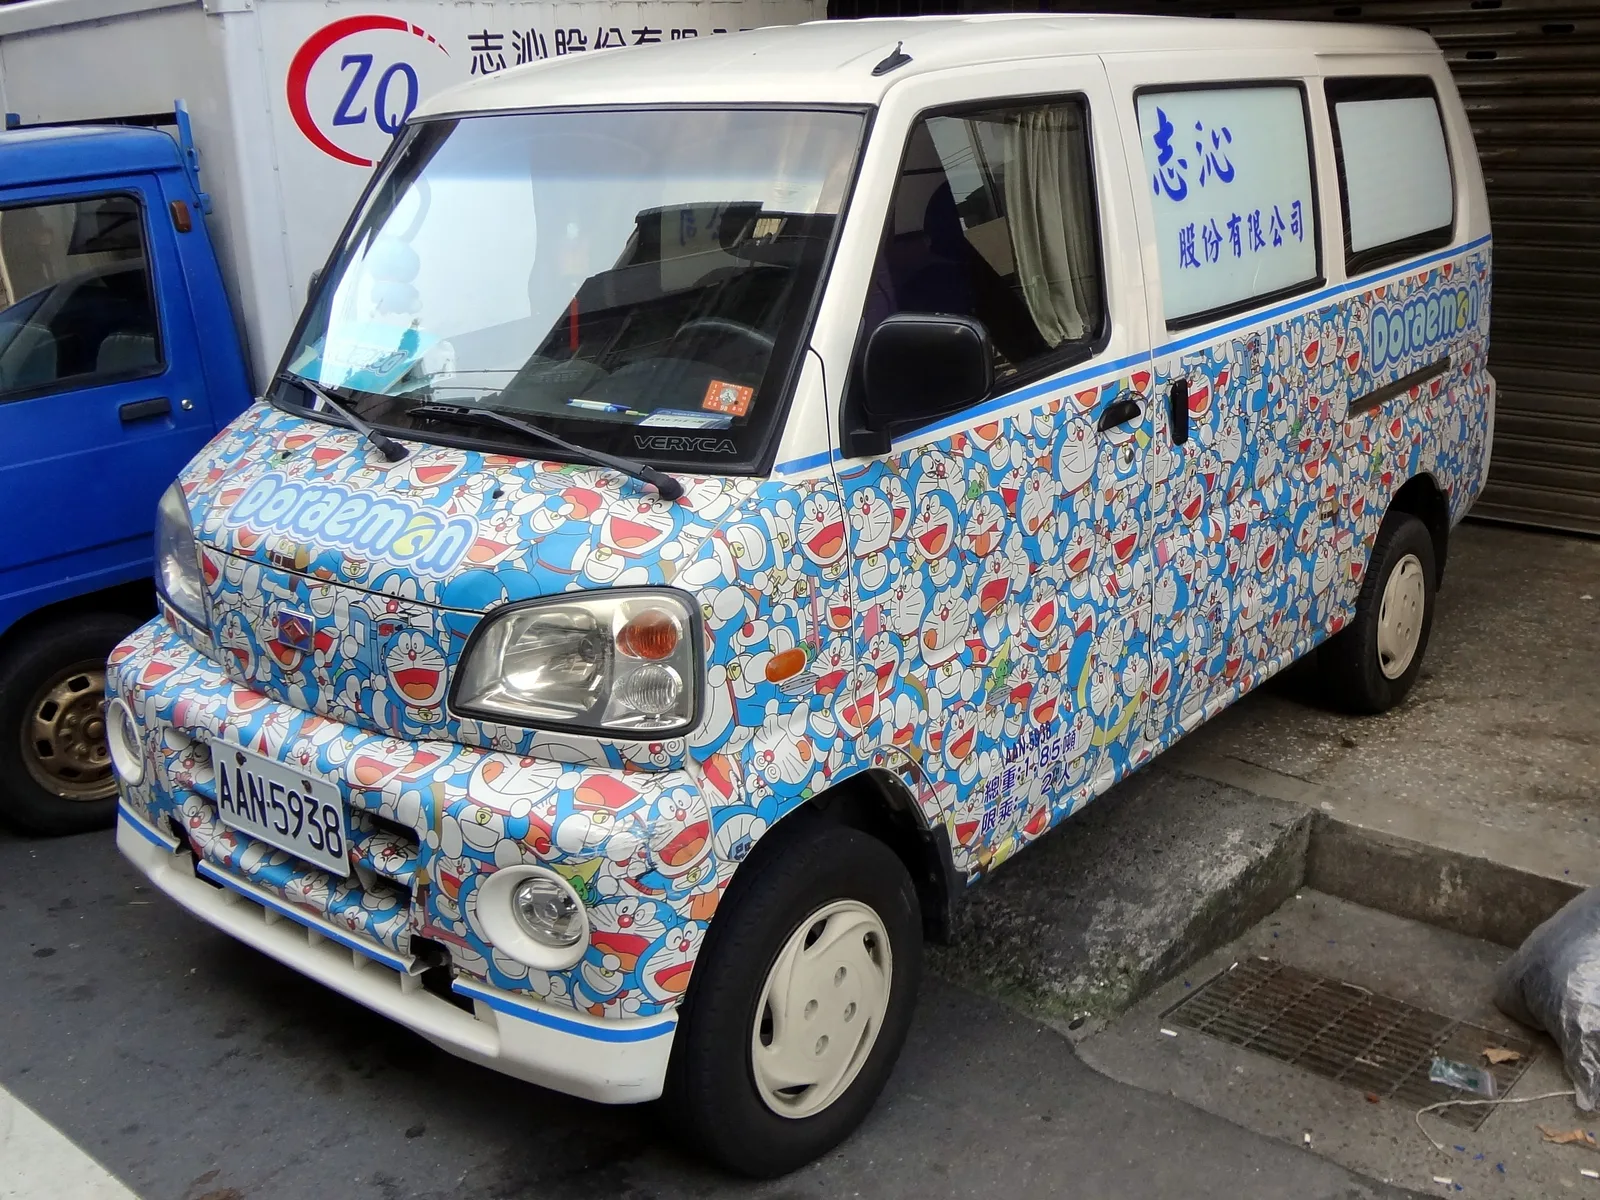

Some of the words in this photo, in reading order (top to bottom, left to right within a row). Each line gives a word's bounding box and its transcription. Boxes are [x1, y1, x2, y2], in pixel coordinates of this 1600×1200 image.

[332, 53, 419, 135] ZQ
[1179, 199, 1304, 270] 股份有限公司
[1371, 281, 1480, 373] Doraemon
[634, 435, 737, 454] VERYCA
[226, 473, 475, 574] Doraemon
